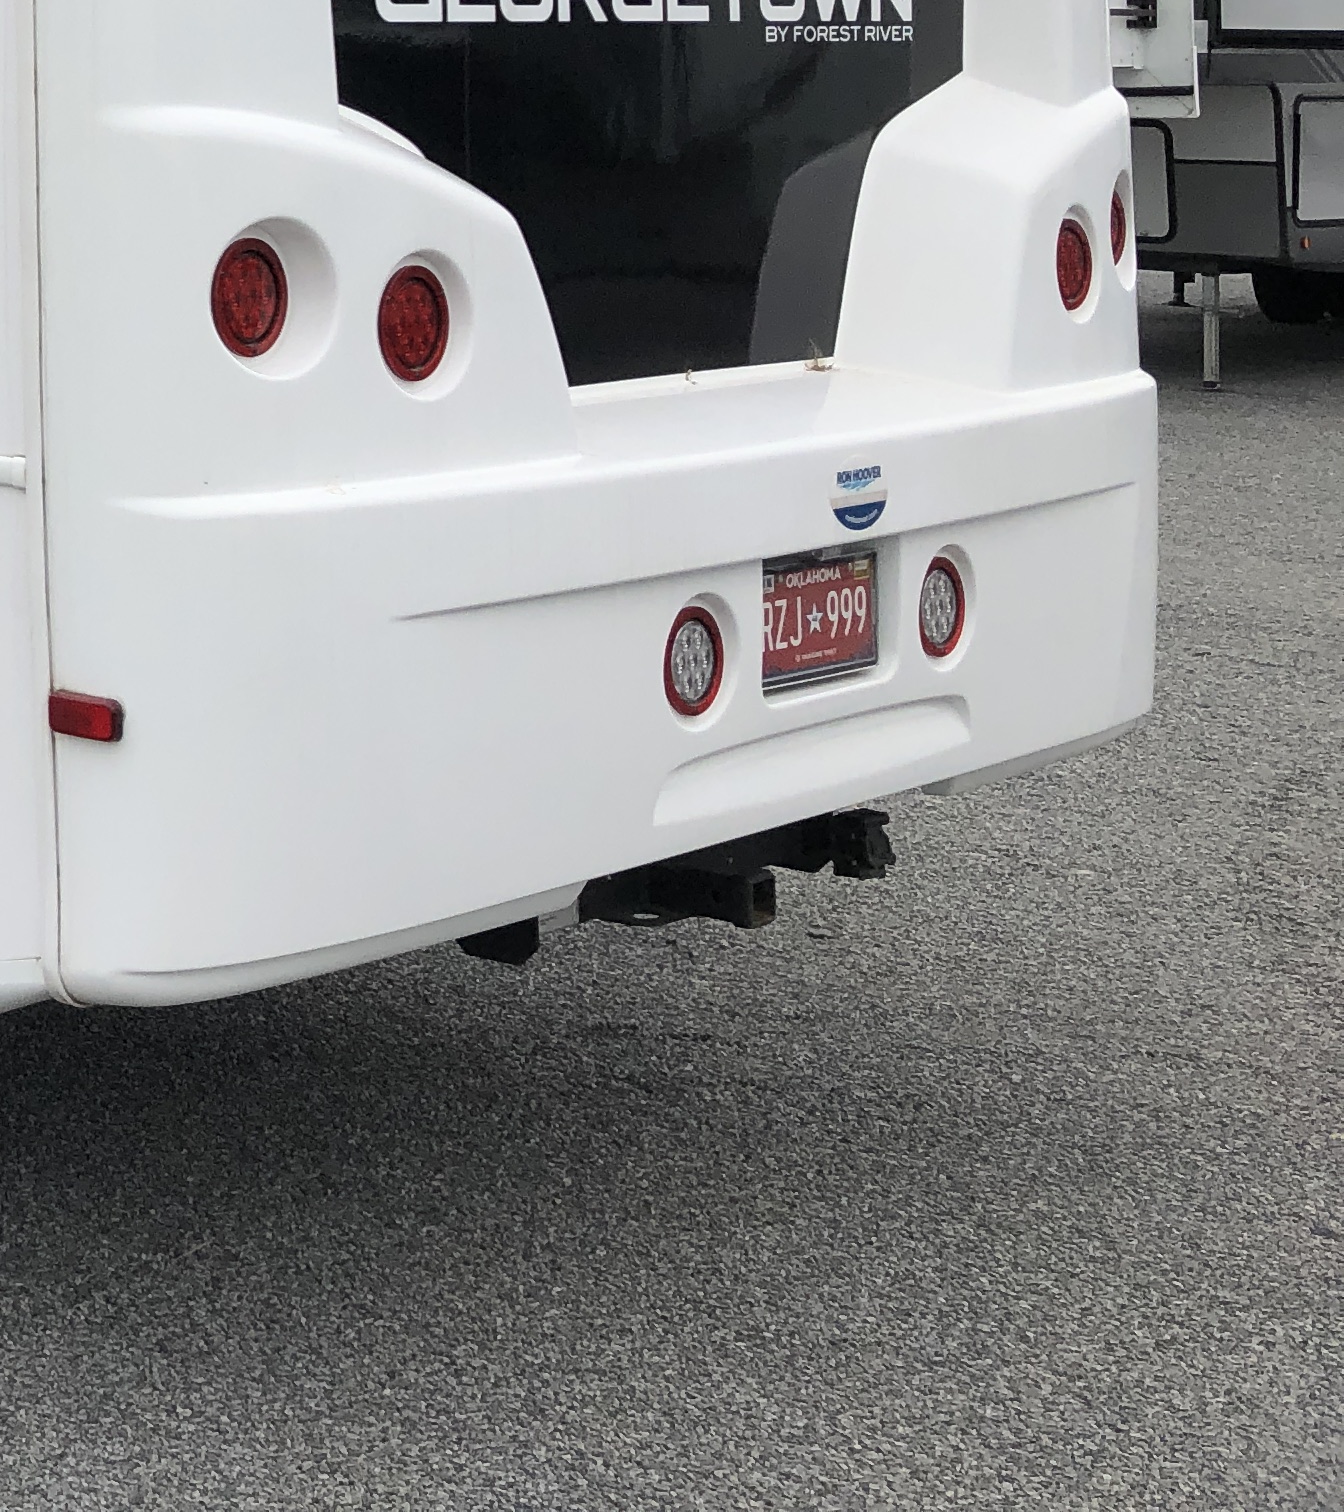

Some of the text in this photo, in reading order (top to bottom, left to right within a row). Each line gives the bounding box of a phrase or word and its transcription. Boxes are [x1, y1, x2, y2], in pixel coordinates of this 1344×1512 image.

[764, 25, 914, 43] BY FOREST RIVER
[785, 567, 842, 589] OKLAHOMA
[826, 585, 867, 640] 999
